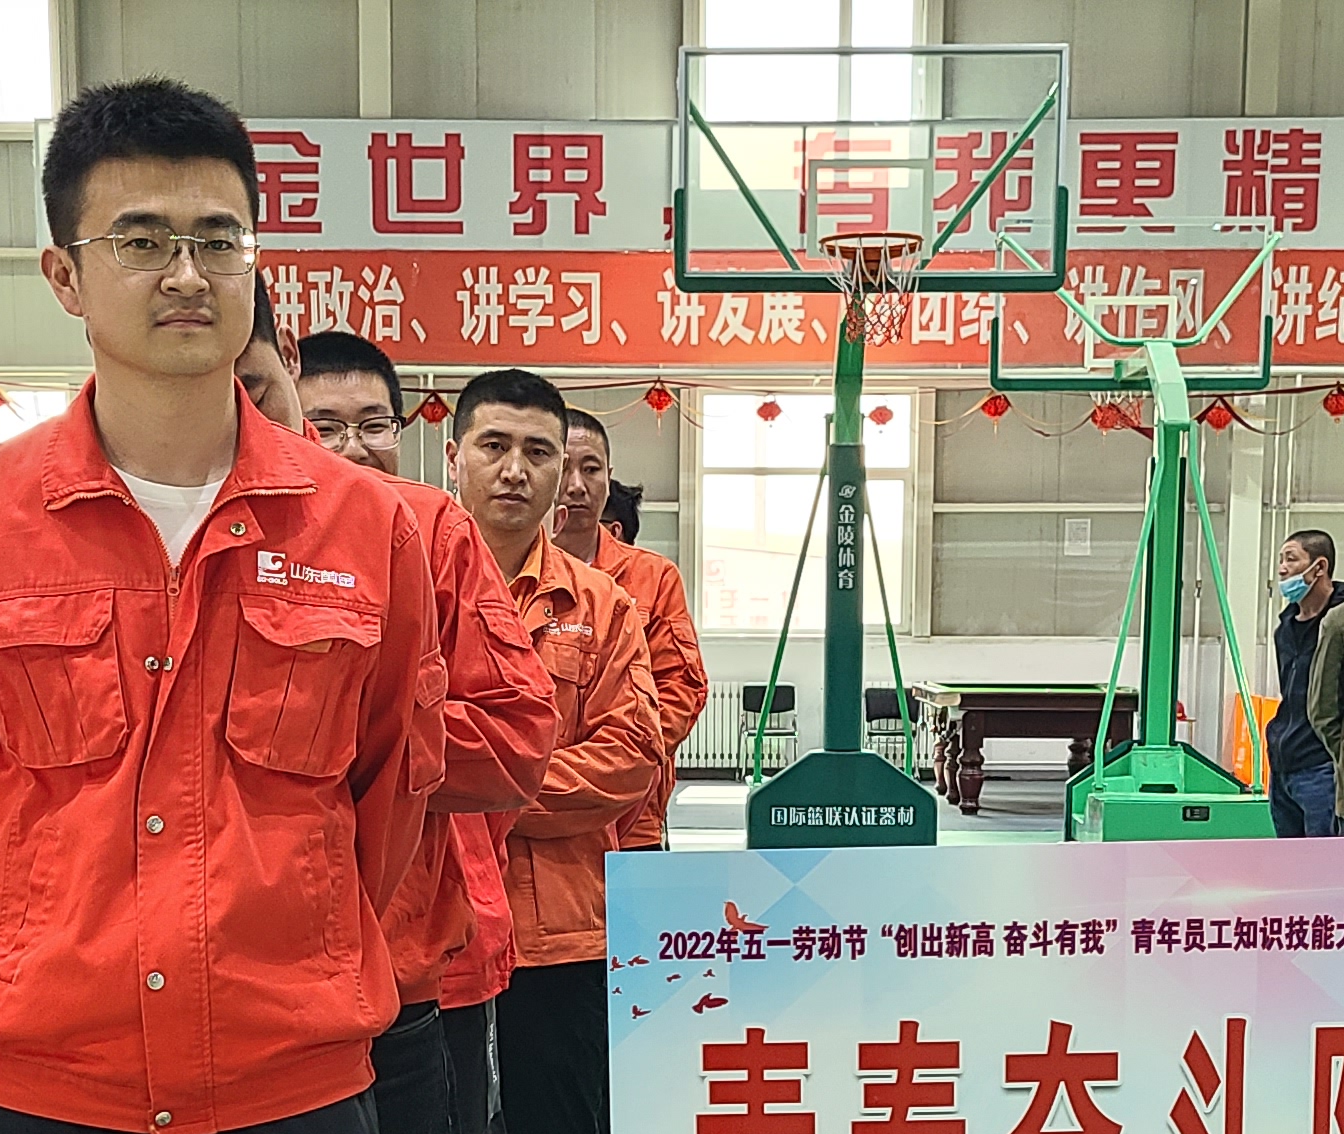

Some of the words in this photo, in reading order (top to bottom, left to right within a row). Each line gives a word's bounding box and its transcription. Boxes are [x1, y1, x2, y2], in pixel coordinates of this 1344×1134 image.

[770, 805, 915, 827] 国际篮联认证器材
